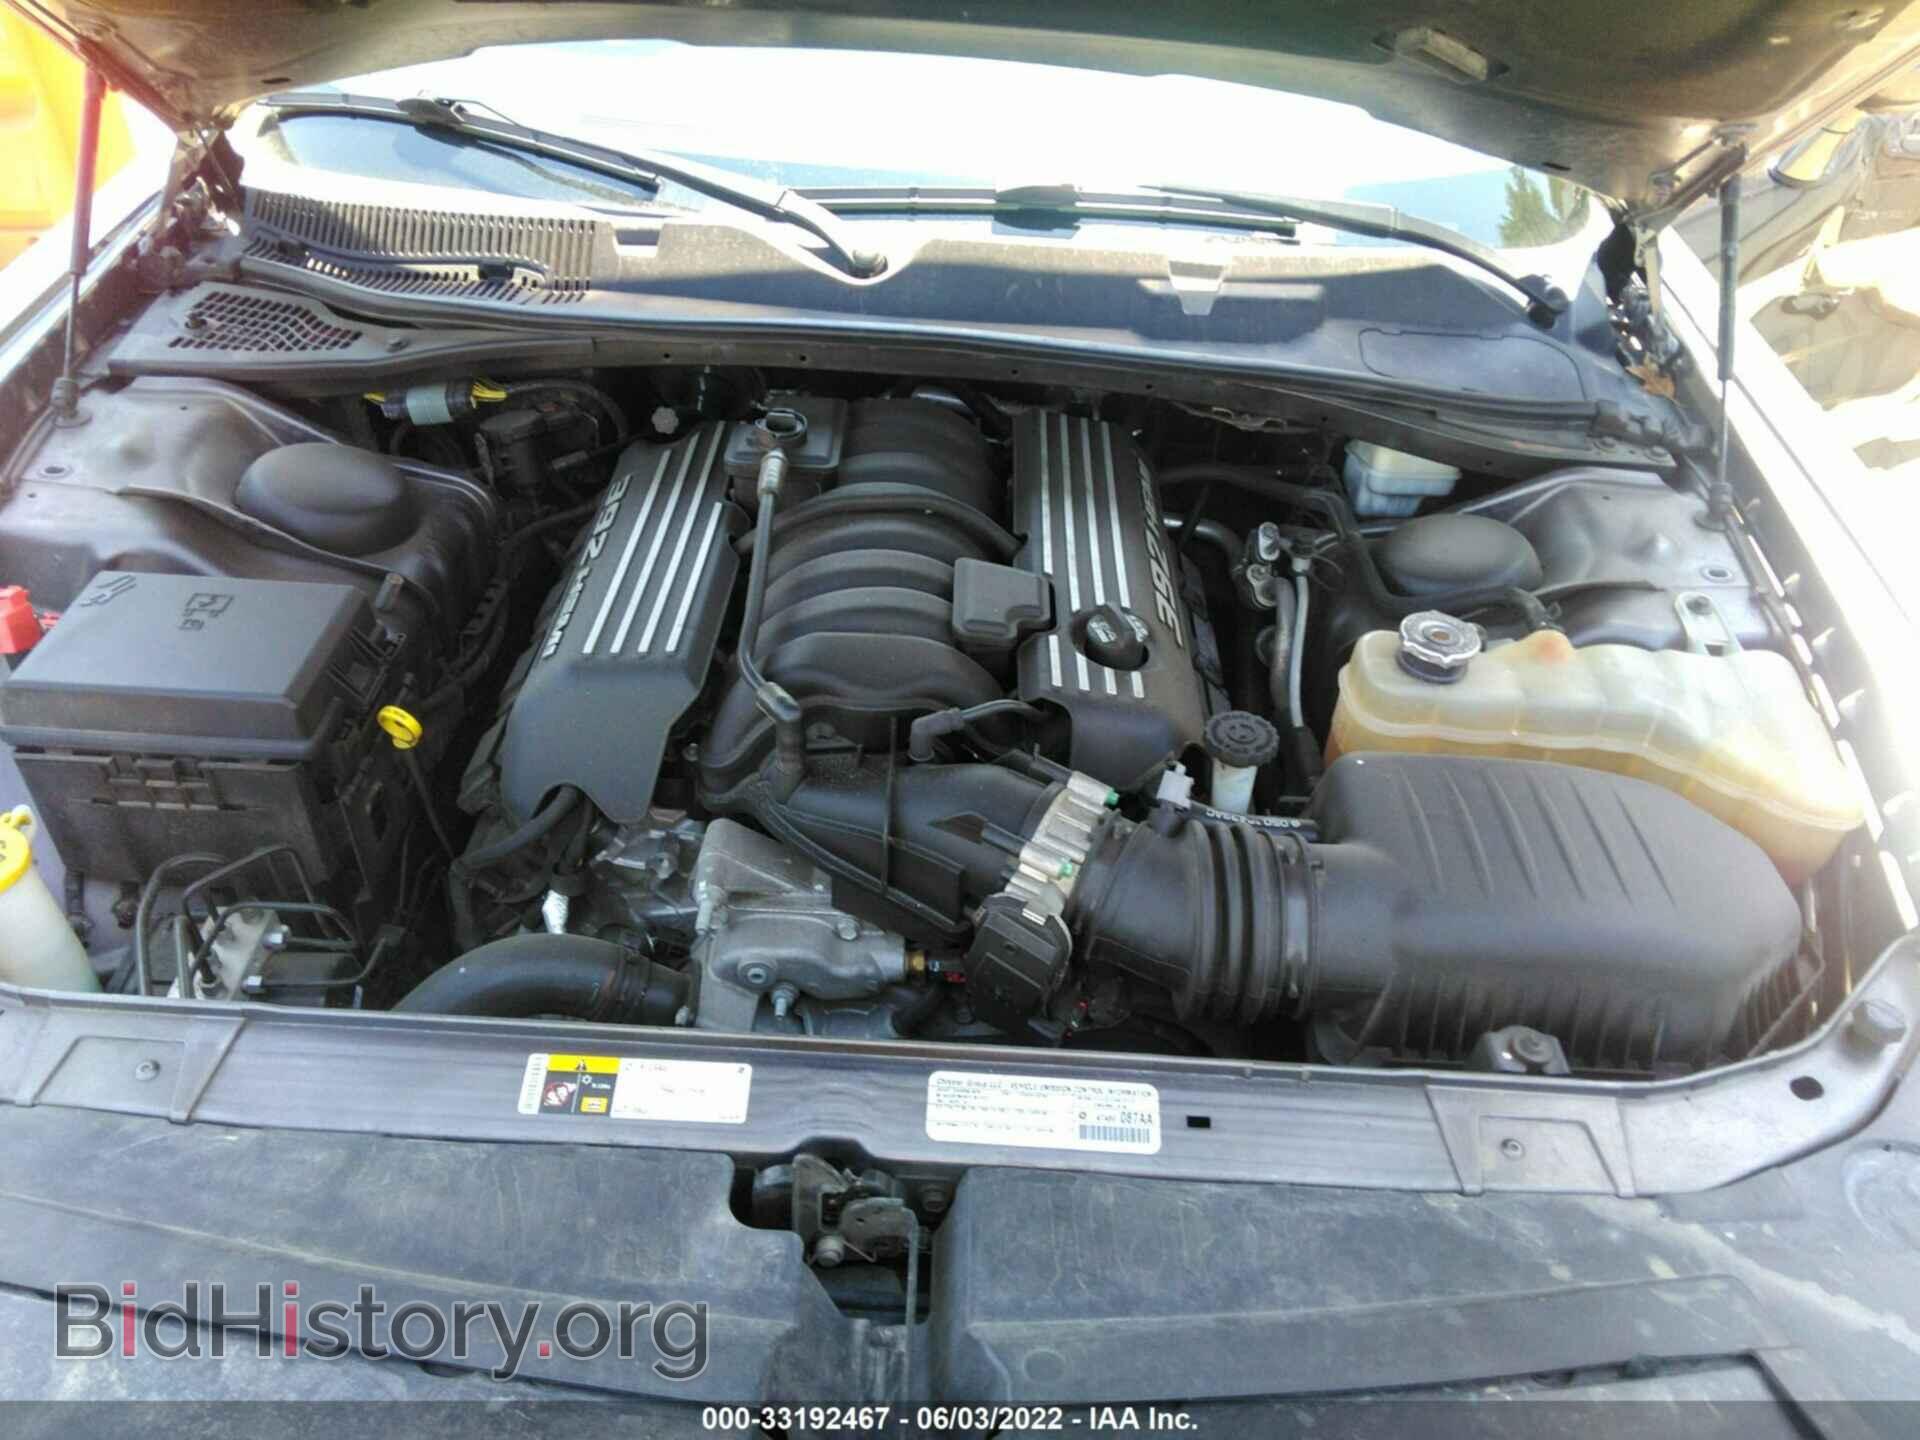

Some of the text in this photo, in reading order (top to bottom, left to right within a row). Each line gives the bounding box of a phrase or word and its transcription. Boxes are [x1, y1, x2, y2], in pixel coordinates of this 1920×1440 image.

[542, 473, 632, 660] 392 HEMI
[1145, 528, 1184, 648] 392
